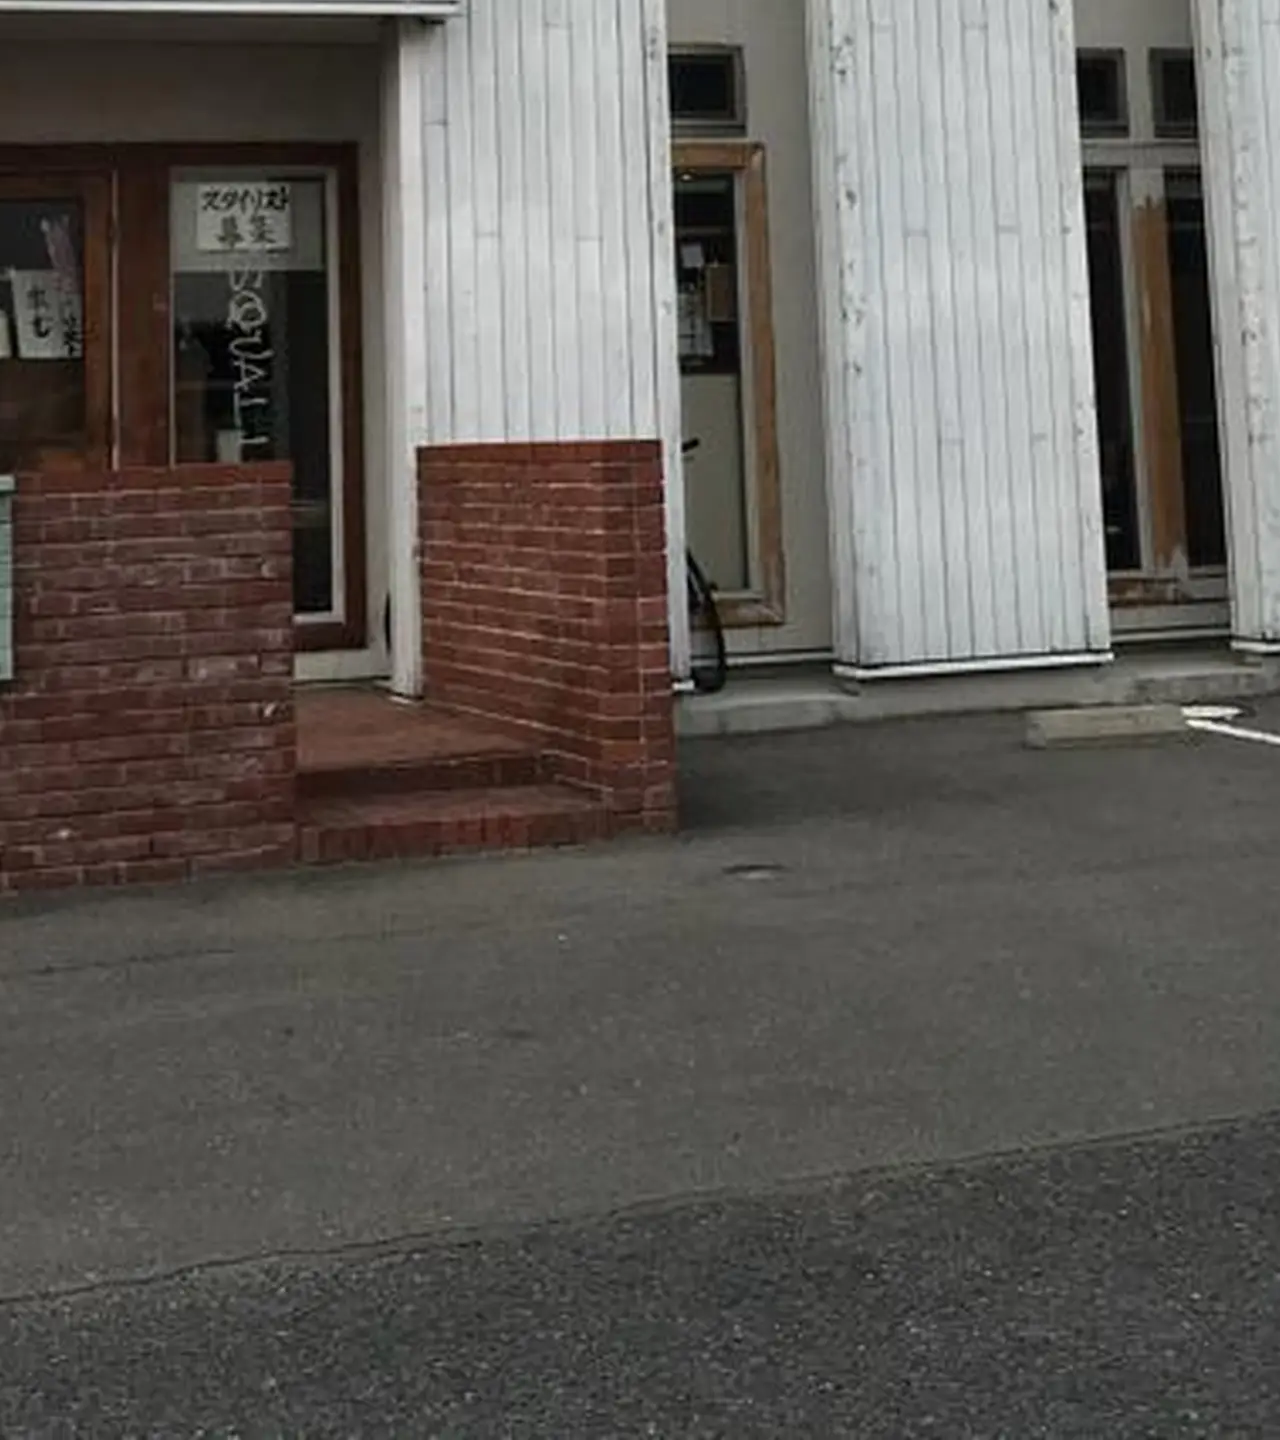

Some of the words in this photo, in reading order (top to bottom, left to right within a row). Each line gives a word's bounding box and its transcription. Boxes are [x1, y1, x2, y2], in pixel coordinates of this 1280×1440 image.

[201, 186, 289, 213] スタイリスト
